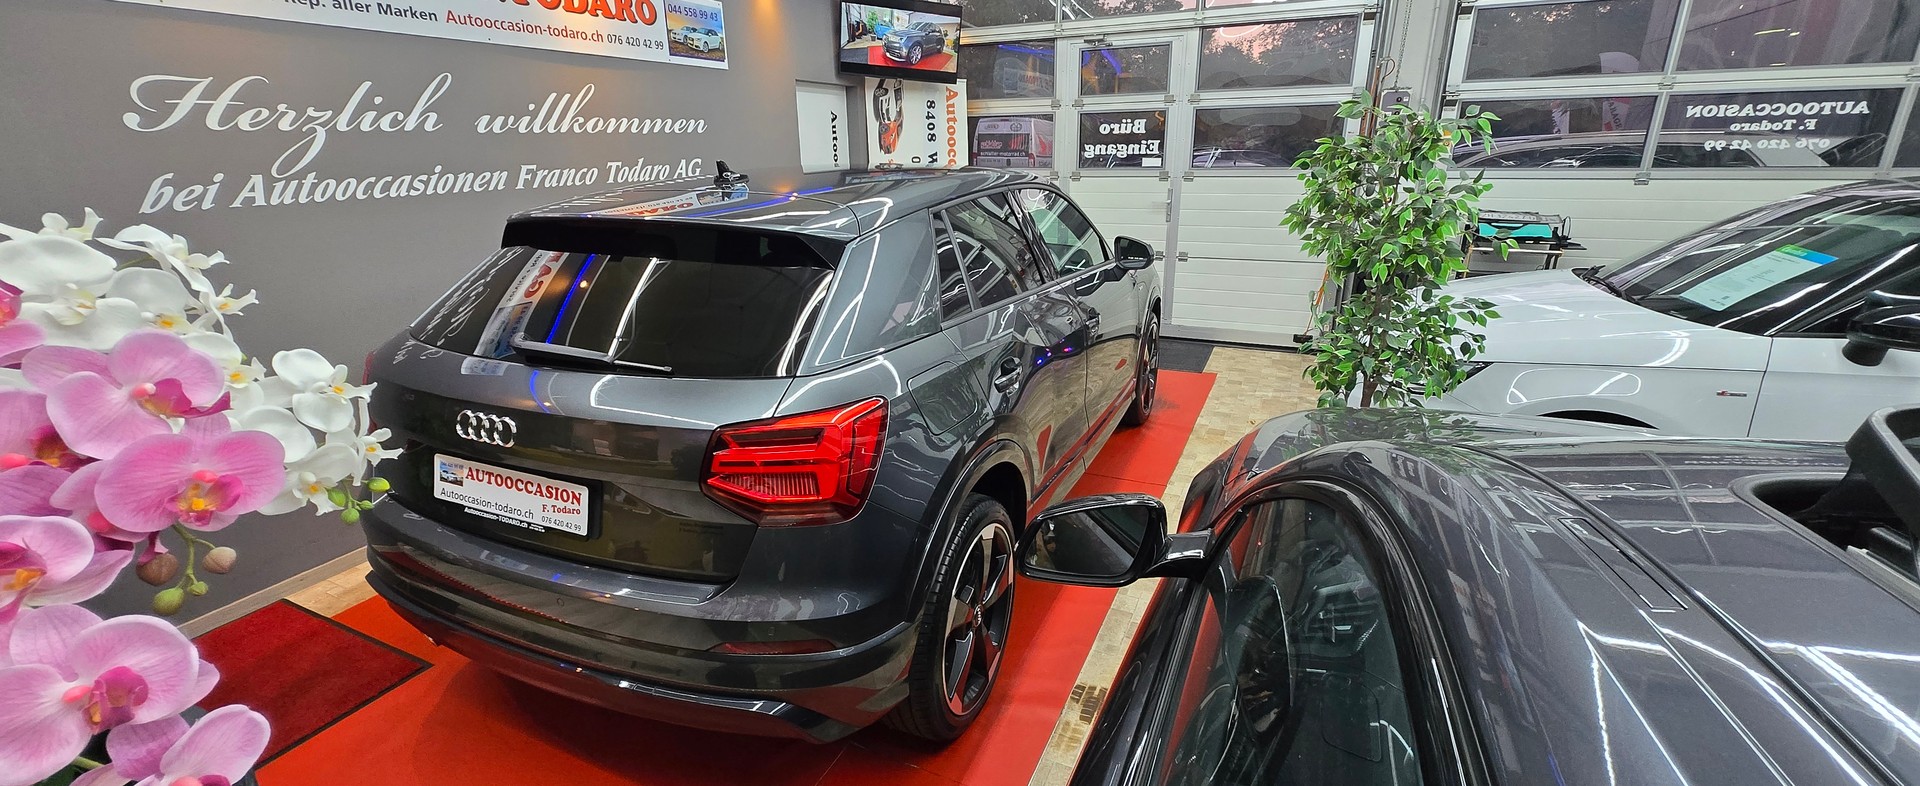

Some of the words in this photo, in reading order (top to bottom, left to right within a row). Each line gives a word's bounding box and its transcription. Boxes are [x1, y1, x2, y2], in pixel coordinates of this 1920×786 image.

[285, 0, 326, 10] ep.
[332, 0, 372, 14] aller
[377, 2, 439, 22] Marken
[446, 10, 604, 43] Autooccasion-todaro.ch
[607, 33, 624, 45] 076
[625, 36, 641, 48] 420
[642, 39, 653, 49] 42
[654, 40, 664, 51] 99
[511, 0, 658, 26] ARO
[668, 4, 682, 15] 044
[684, 7, 698, 18] 558
[699, 10, 708, 20] 99
[709, 12, 718, 22] 43
[122, 72, 452, 178] Herzlich
[474, 83, 708, 135] willkommen
[926, 99, 938, 143] 8408
[138, 172, 225, 214] bei
[229, 164, 509, 208] Autooccasionen
[515, 163, 599, 190] Franco
[606, 157, 670, 184] Todaro
[673, 157, 702, 180] AG
[440, 487, 534, 520] Autooccasion-todaro.ch
[465, 466, 582, 507] AUTOOCCASION
[541, 515, 552, 524] 076
[552, 517, 564, 528] 420
[565, 521, 573, 530] 42
[573, 523, 582, 532] 99
[542, 504, 550, 513] F.
[551, 504, 581, 515] Todaro
